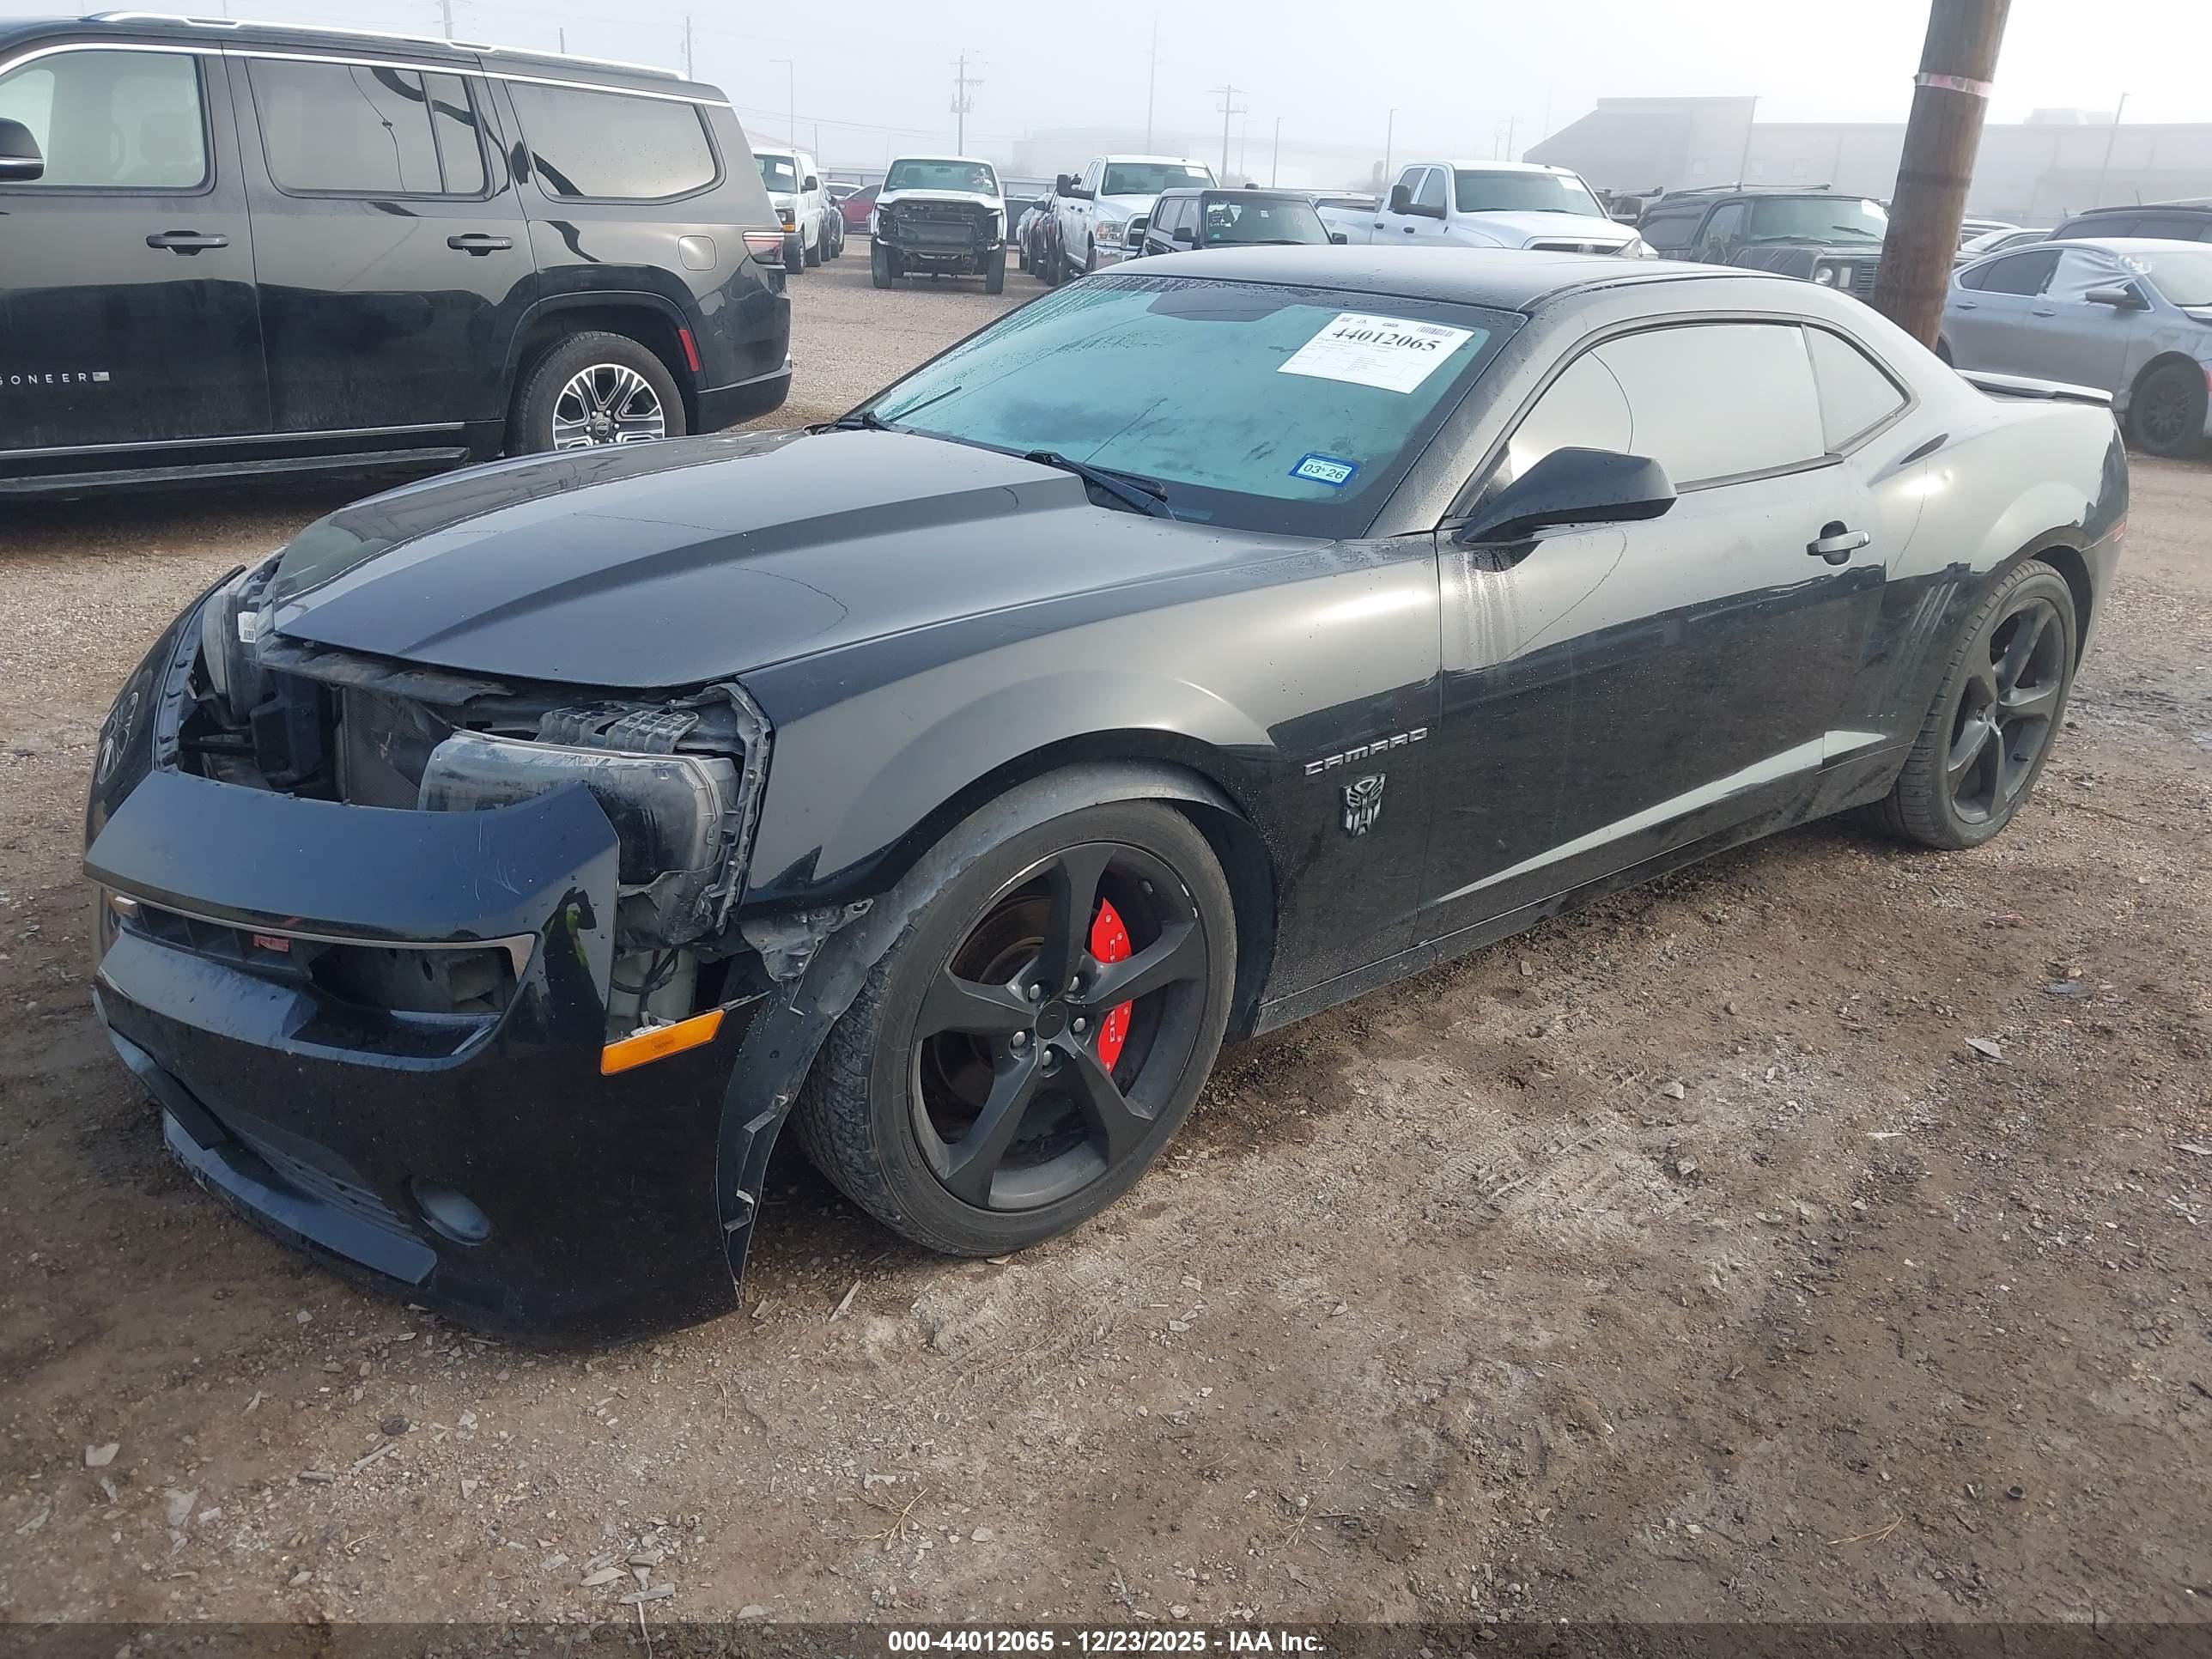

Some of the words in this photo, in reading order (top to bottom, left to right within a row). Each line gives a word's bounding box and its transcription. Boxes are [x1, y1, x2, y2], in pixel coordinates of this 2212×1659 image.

[1333, 326, 1441, 351] 44012065
[1304, 464, 1322, 474] 03
[1326, 468, 1346, 479] 26
[1304, 727, 1428, 776] CAMARO
